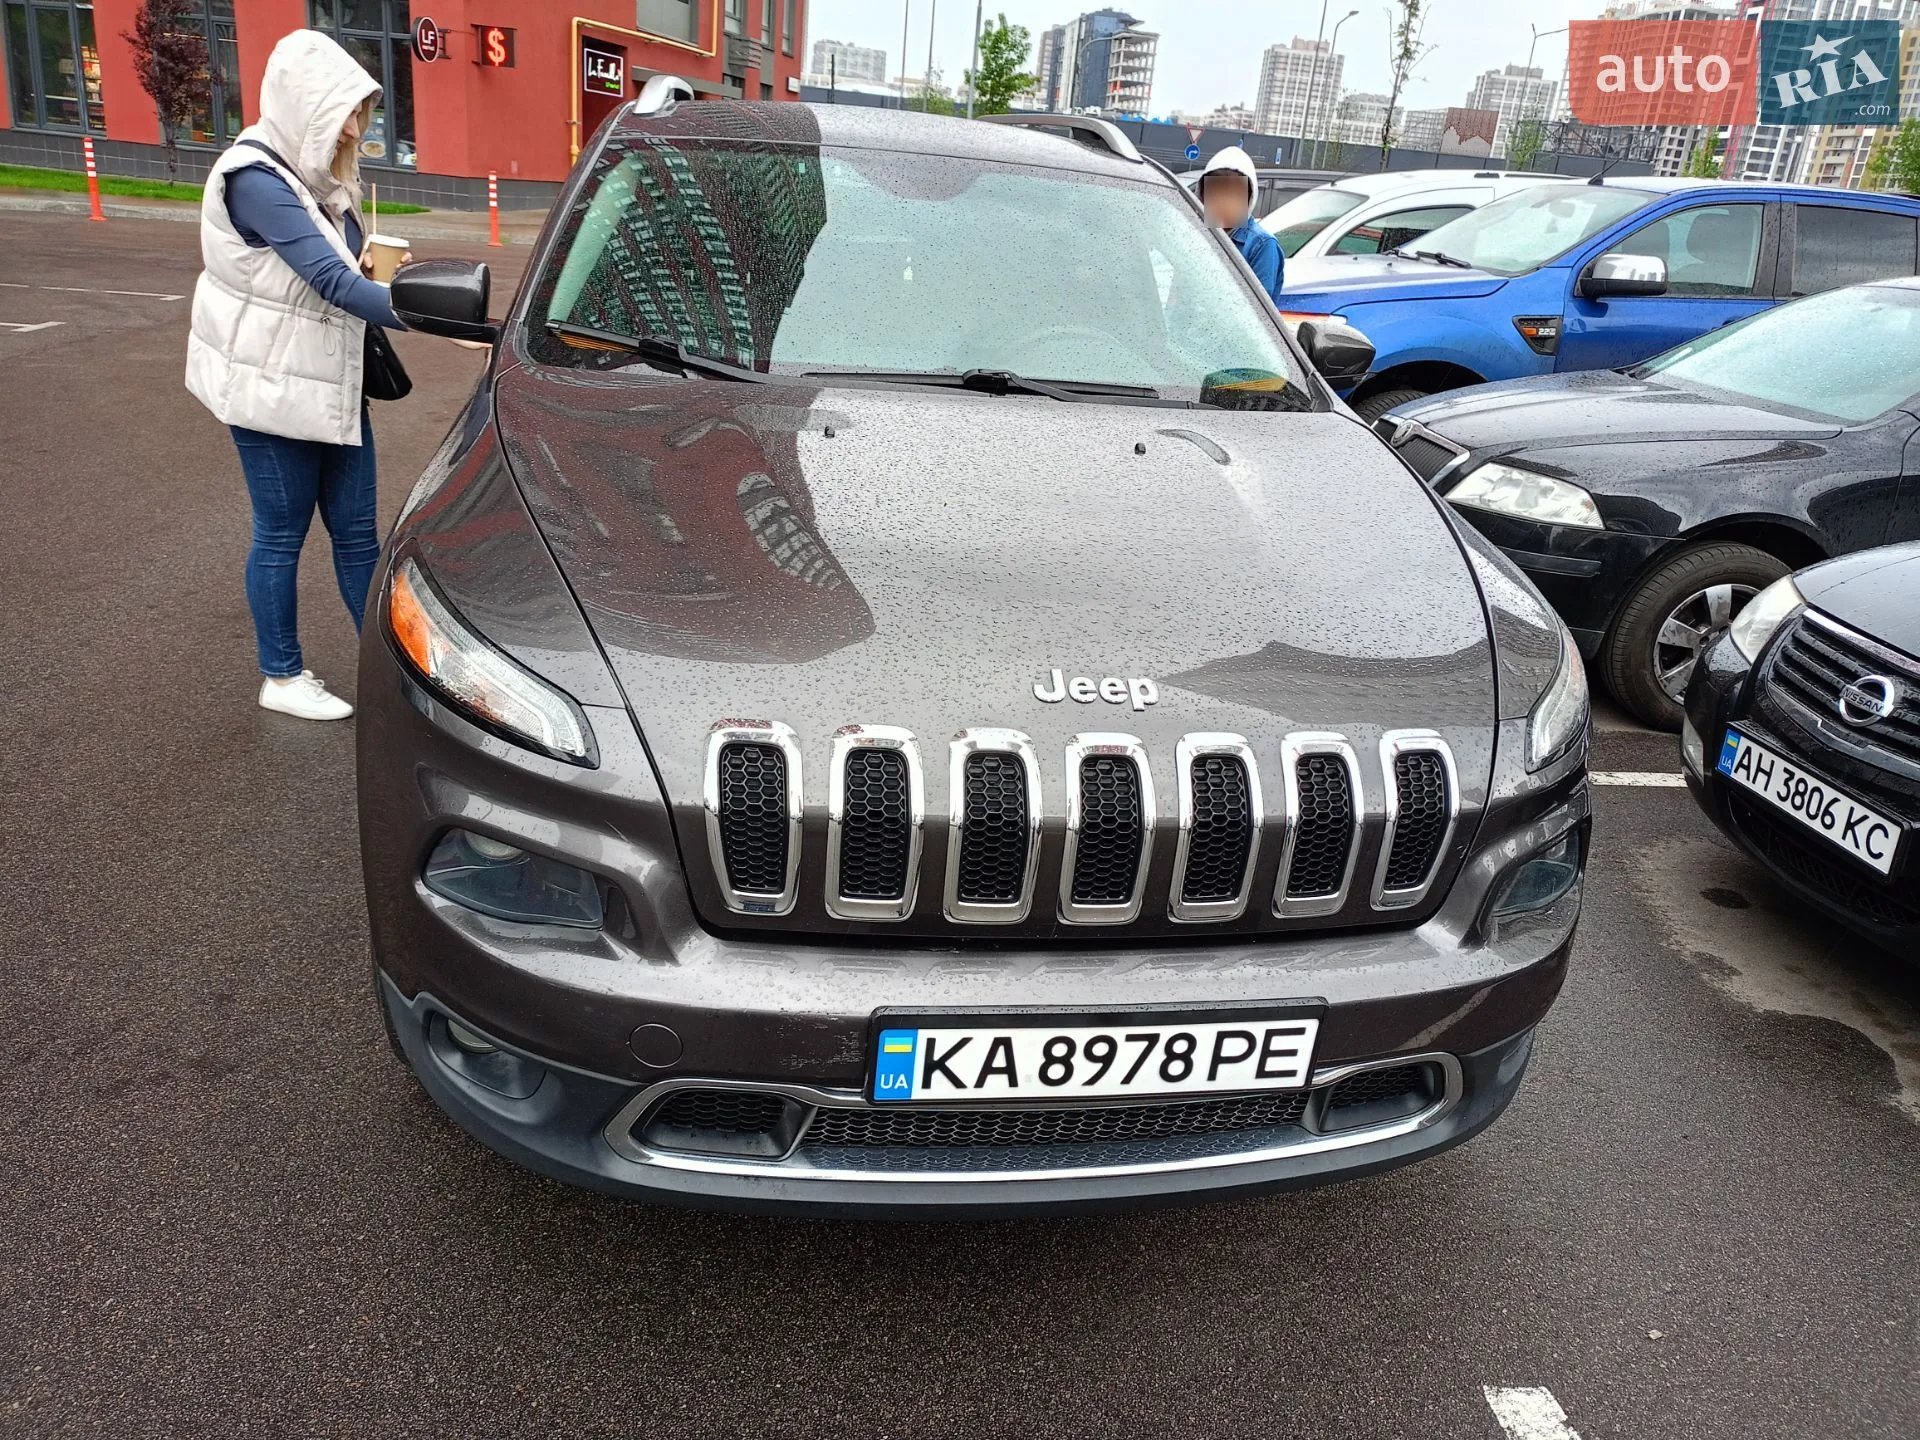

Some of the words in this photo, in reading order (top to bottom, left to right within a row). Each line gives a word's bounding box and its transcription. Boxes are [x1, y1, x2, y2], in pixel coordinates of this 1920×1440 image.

[421, 28, 435, 44] LF
[487, 28, 506, 66] $
[1032, 668, 1160, 712] Jeep
[1842, 688, 1883, 713] NISSAN
[1721, 755, 1732, 770] UA
[1733, 745, 1775, 792] AH
[1776, 767, 1841, 830] 3806
[1841, 806, 1889, 860] KC
[921, 1036, 1019, 1089] KA
[1037, 1032, 1197, 1087] 8978
[1206, 1027, 1307, 1082] PE
[880, 1074, 909, 1090] UA
